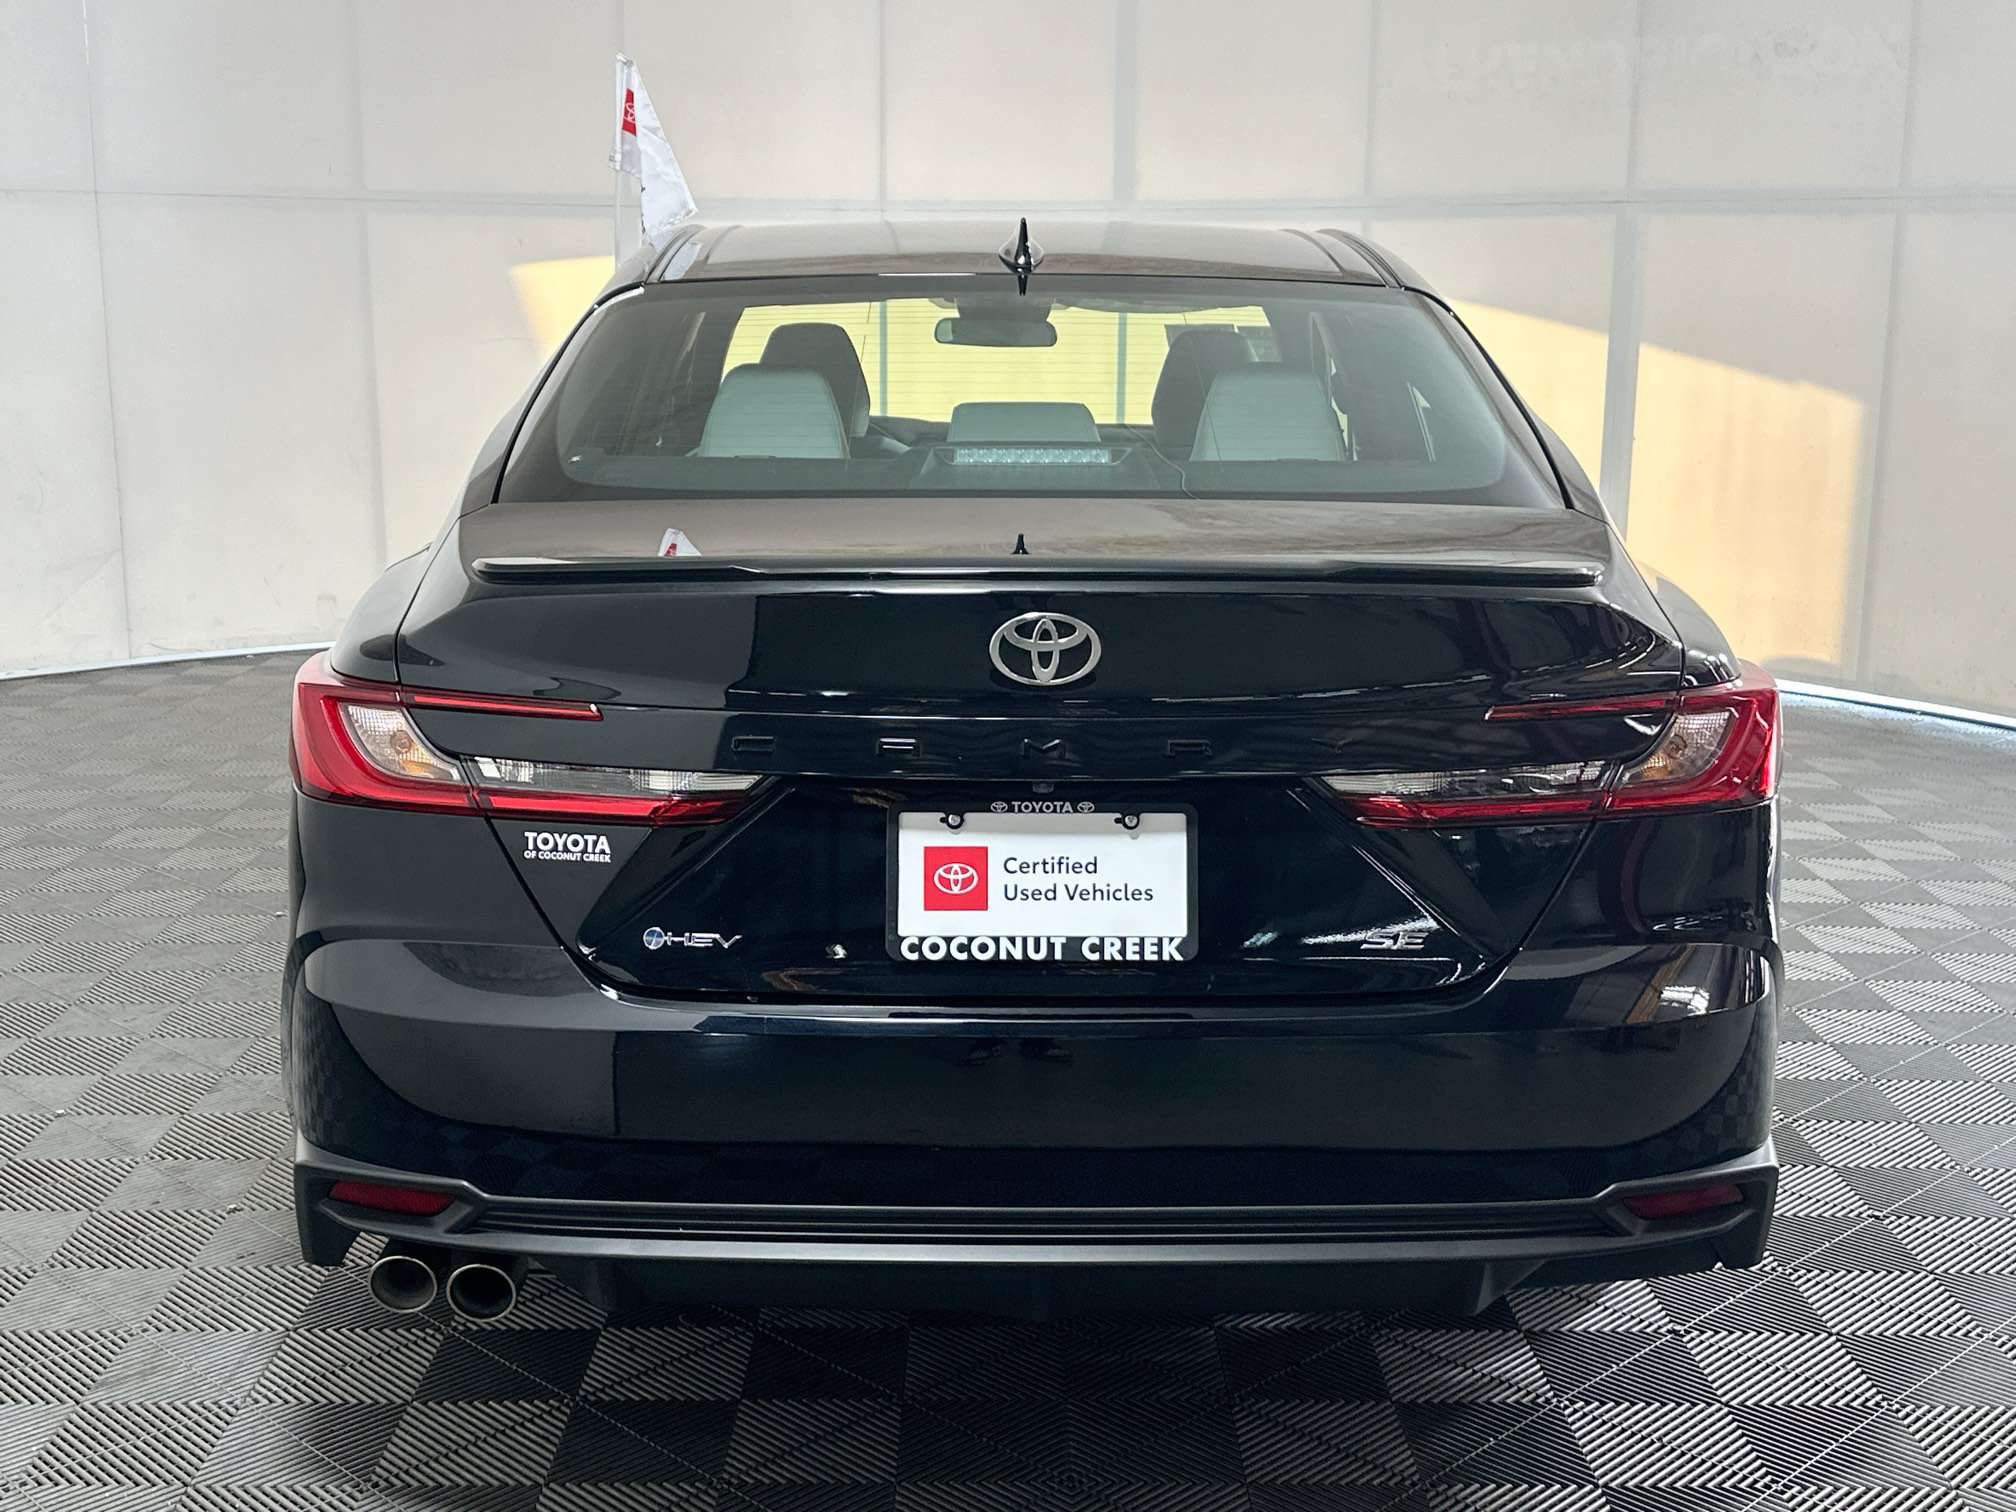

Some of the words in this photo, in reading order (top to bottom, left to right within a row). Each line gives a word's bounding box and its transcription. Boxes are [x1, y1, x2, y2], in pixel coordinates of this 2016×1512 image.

[1011, 801, 1073, 813] TOYOTA
[524, 831, 610, 853] TOYOTA
[524, 850, 536, 859] OF
[538, 851, 582, 861] COCONUT
[583, 852, 611, 862] CREEK
[1003, 856, 1098, 874] Certified
[1003, 883, 1057, 901] Used
[1064, 883, 1154, 901] Vehicles
[664, 932, 742, 948] HEV
[900, 937, 1067, 961] COCONUT
[1081, 937, 1183, 961] CREEK
[1360, 931, 1429, 950] SE
